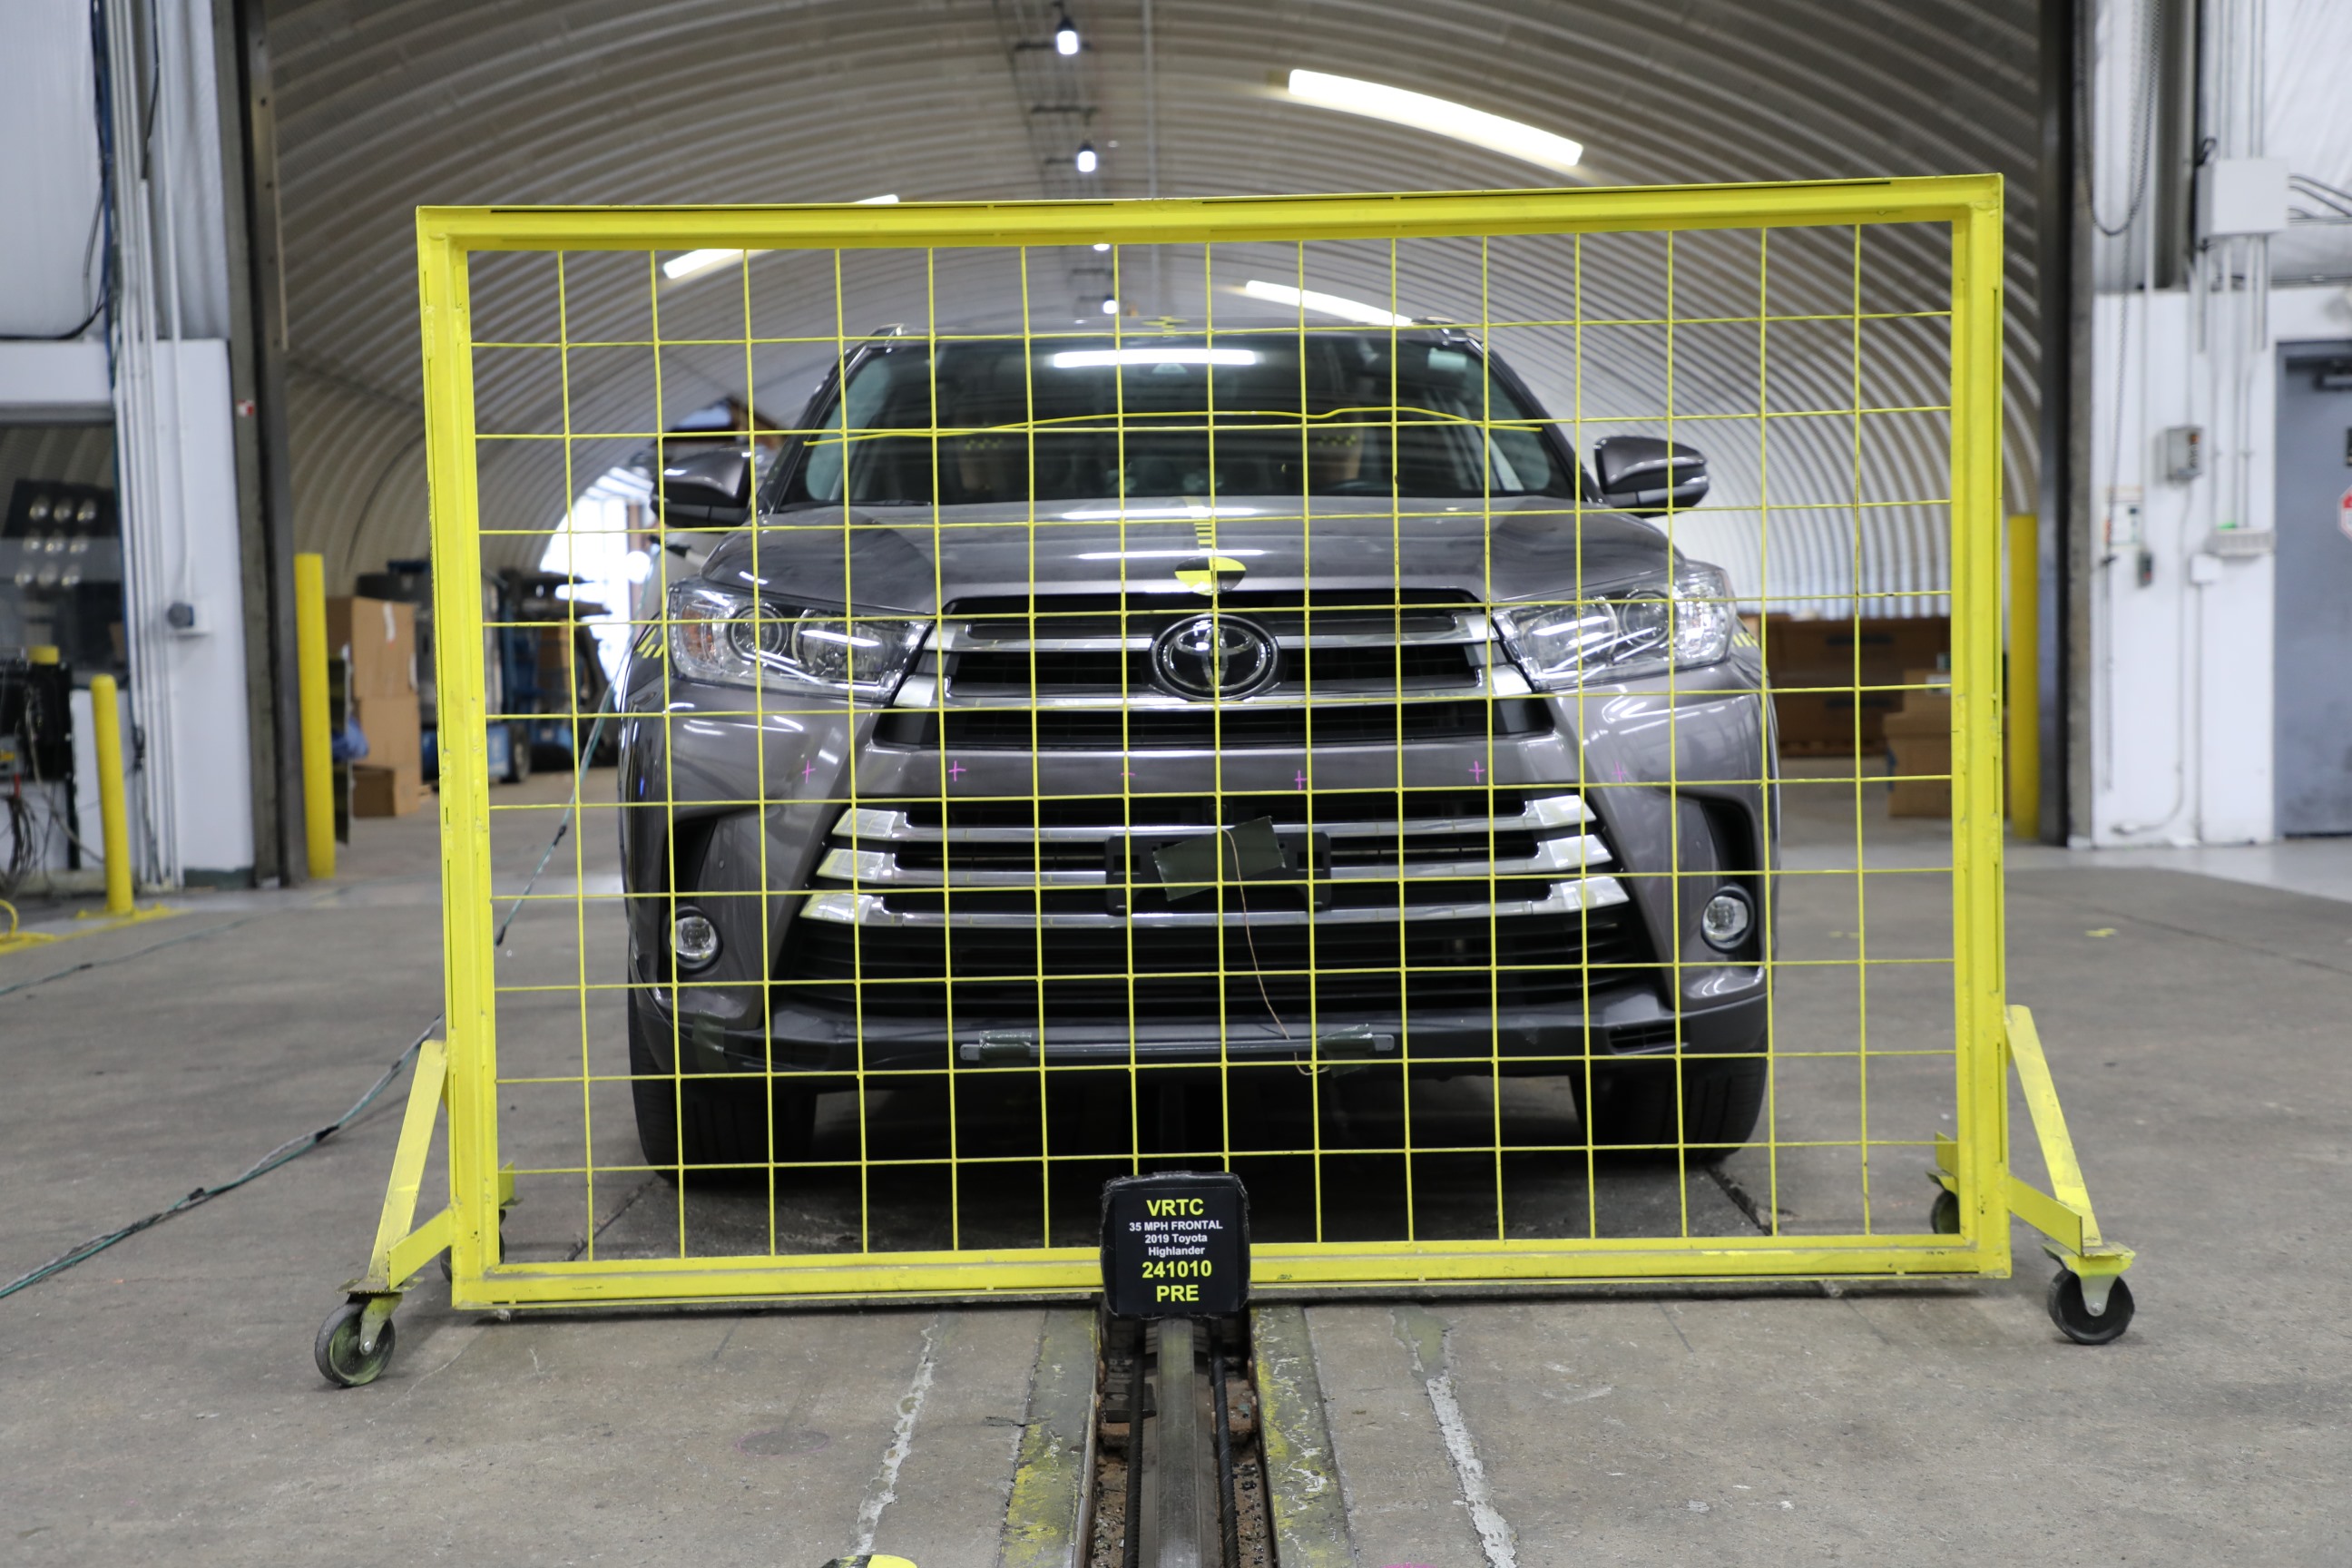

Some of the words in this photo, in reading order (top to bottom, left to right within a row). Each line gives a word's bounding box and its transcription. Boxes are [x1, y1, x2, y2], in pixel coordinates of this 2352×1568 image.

[1146, 1198, 1204, 1217] VRTC
[1129, 1222, 1142, 1231] 35
[1144, 1221, 1169, 1231] MPH
[1171, 1220, 1223, 1230] FRONTAL
[1144, 1234, 1170, 1244] 2019
[1171, 1233, 1208, 1245] Toyota
[1148, 1246, 1205, 1258] Highlander
[1142, 1259, 1212, 1279] 241010
[1157, 1284, 1200, 1302] PRE
